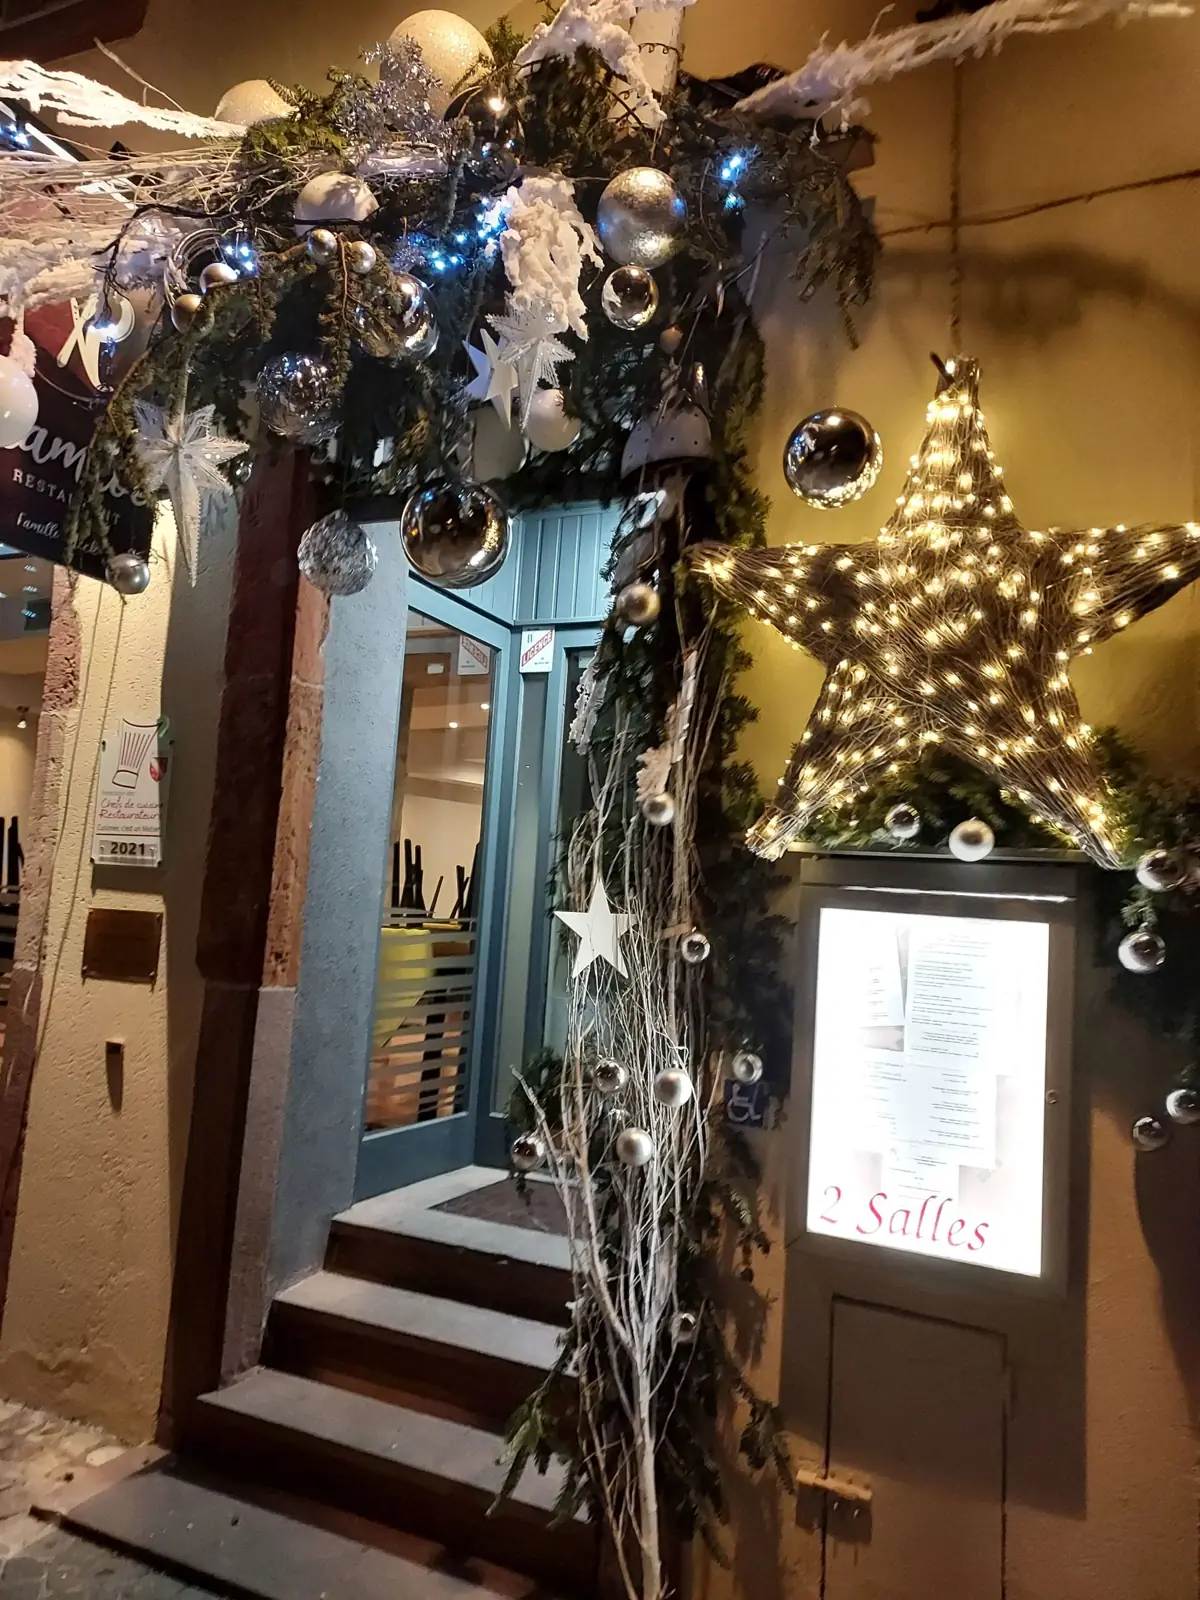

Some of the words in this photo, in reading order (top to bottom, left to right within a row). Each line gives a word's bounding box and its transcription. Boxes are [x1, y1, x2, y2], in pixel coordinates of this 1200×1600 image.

[523, 631, 552, 665] LICENCE
[125, 799, 134, 809] de
[110, 842, 145, 856] 2021
[820, 1185, 841, 1223] 2
[856, 1192, 989, 1250] Salles
